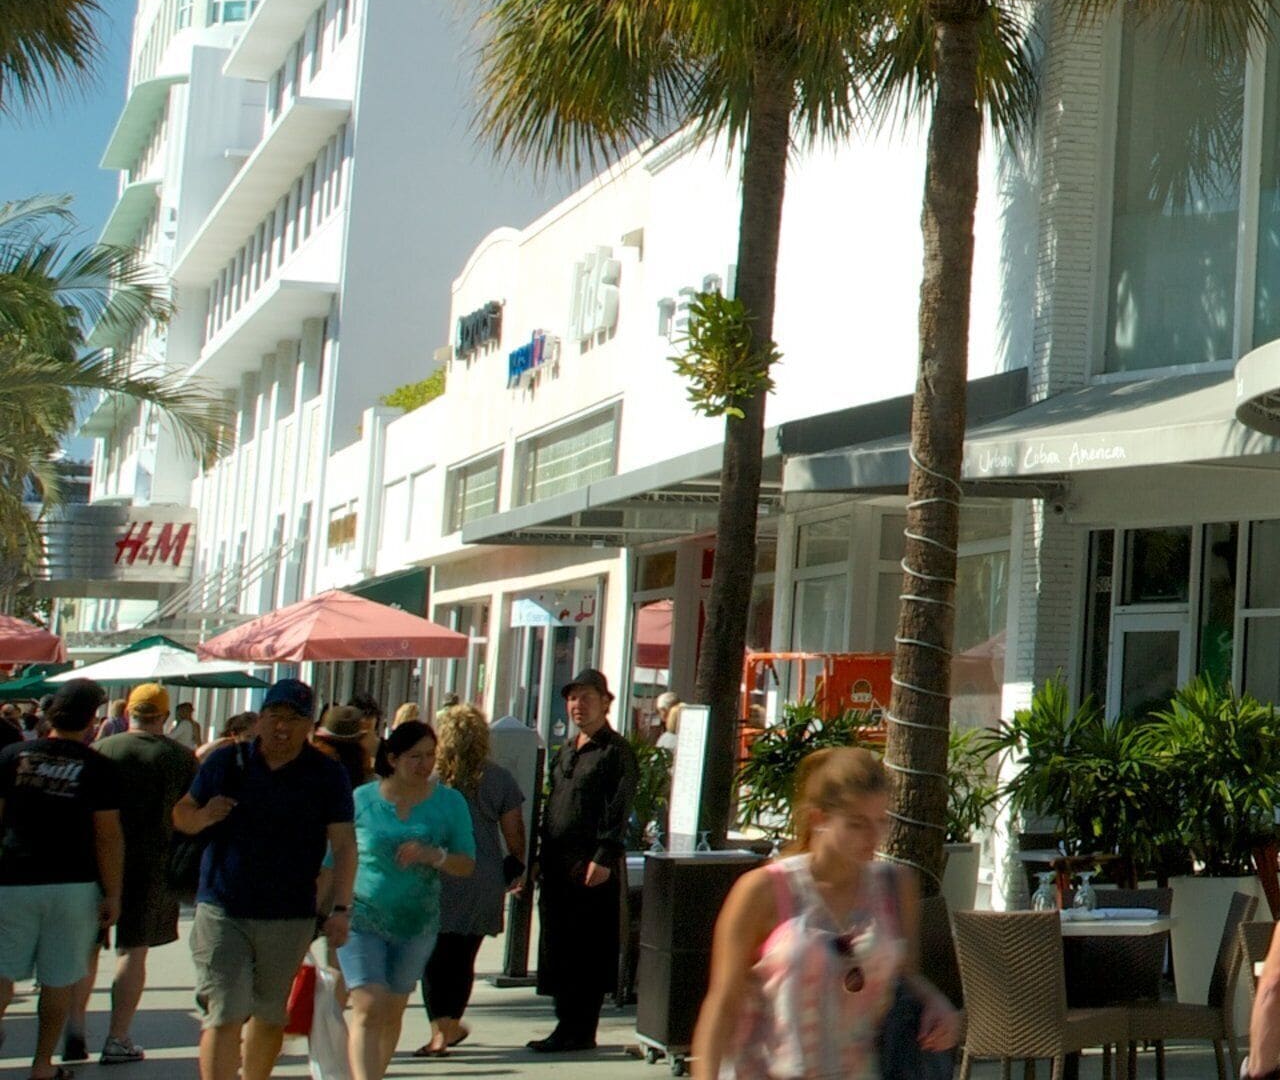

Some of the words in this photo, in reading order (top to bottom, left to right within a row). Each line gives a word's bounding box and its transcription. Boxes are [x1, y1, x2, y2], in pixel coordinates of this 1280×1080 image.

[1023, 443, 1062, 469] Cuban
[1068, 438, 1127, 468] American
[114, 521, 192, 567] H&M
